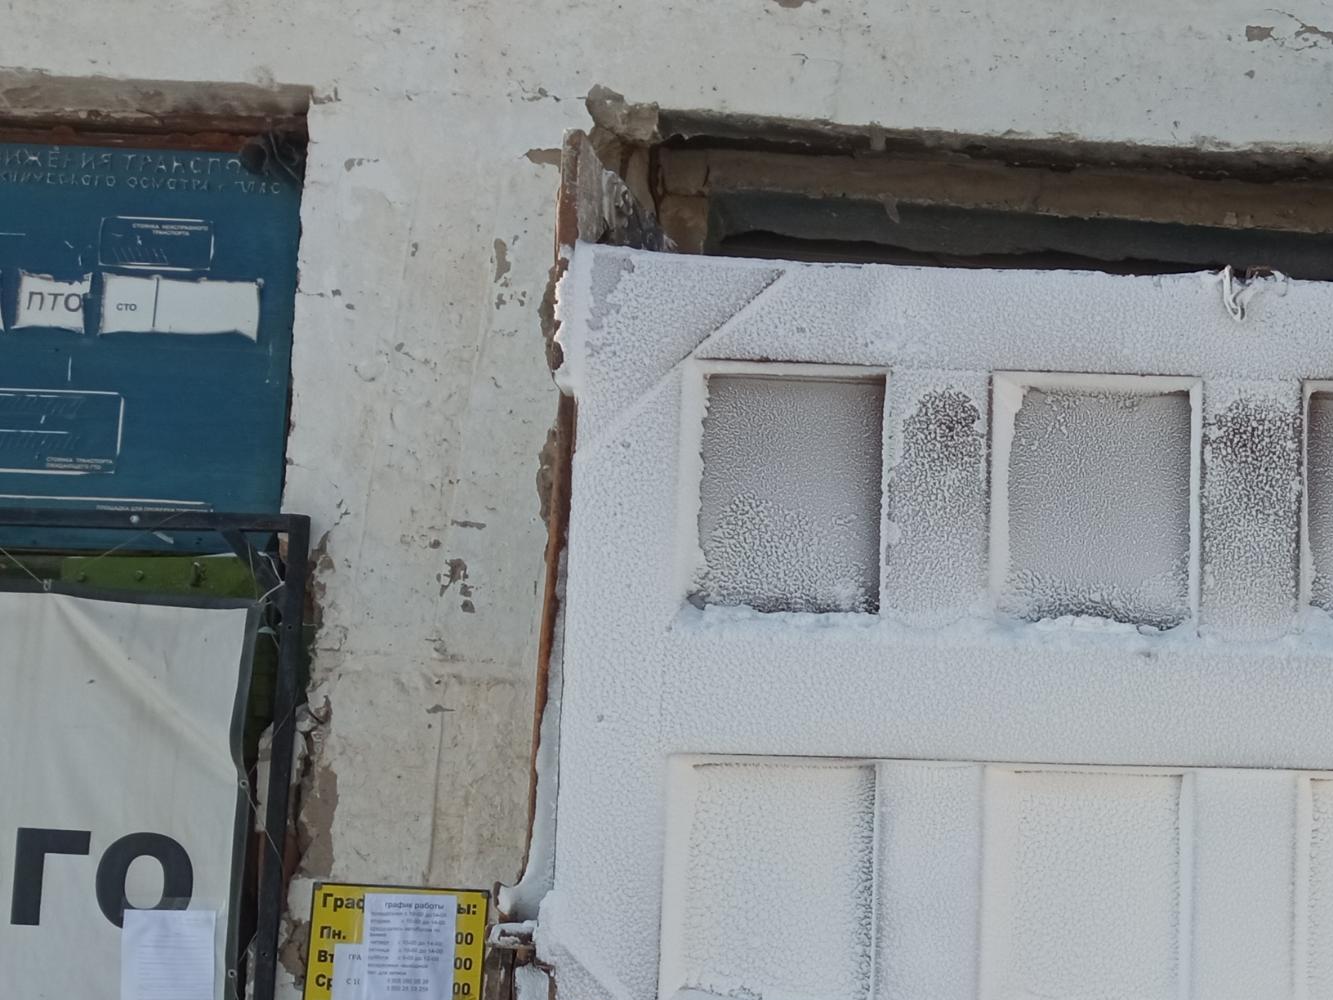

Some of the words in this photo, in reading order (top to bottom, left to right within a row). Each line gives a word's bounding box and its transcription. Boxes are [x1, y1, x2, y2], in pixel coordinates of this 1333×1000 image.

[26, 291, 83, 313] ПТО
[116, 302, 137, 312] СТО
[10, 827, 194, 929] ГО
[319, 925, 347, 940] Пн.
